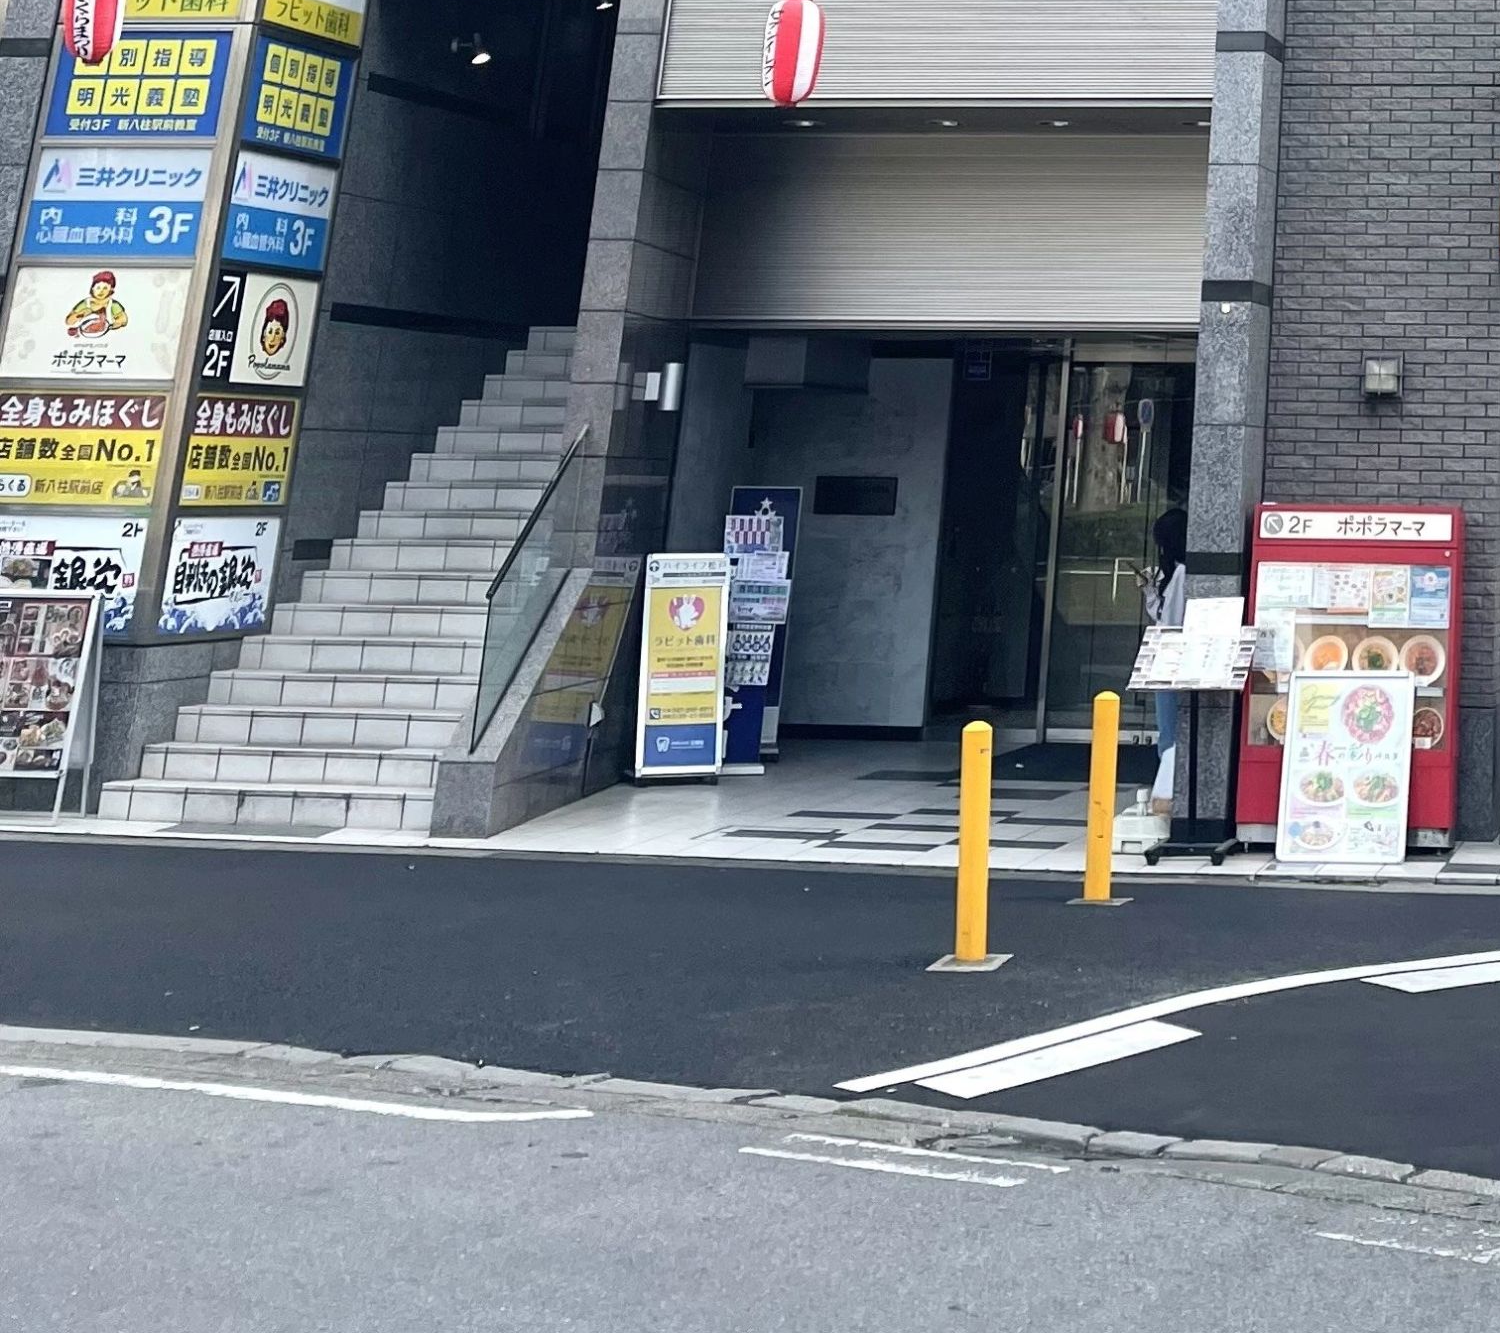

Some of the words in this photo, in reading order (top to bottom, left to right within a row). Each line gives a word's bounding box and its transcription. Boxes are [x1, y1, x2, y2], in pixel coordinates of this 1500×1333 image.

[119, 48, 207, 68] 別指導
[76, 166, 203, 187] 三井クリニック
[255, 174, 329, 208] 三井クリニック
[145, 206, 193, 244] 3F
[290, 219, 316, 256] 3F
[52, 350, 126, 369] ポポラマーマ
[202, 343, 231, 377] 2F
[1, 396, 160, 428] 全身もみほぐし
[194, 399, 290, 436] 全身もみほぐし
[1289, 517, 1313, 533] 2F
[1336, 516, 1426, 537] ポポラマーマ
